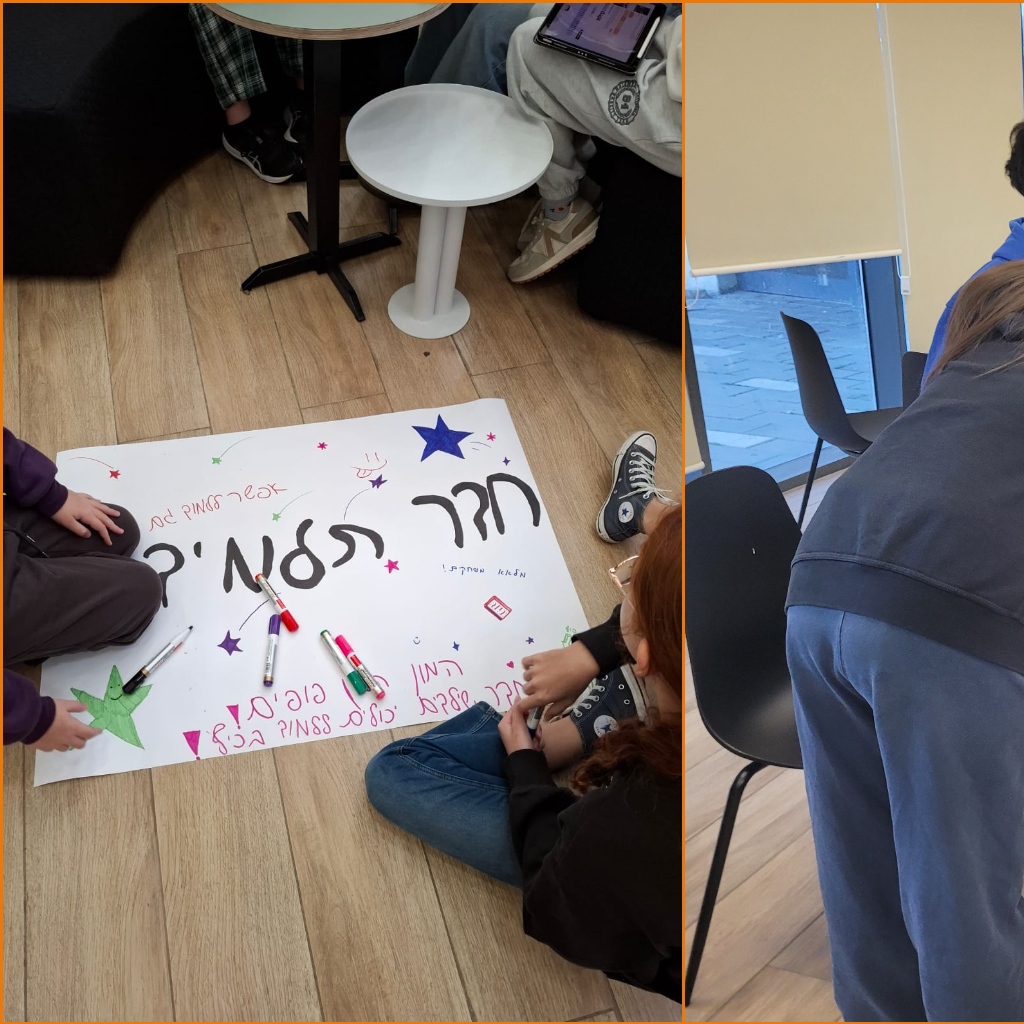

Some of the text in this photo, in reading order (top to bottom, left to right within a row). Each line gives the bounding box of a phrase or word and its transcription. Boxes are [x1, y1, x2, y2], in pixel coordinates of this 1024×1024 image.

[149, 482, 288, 532] אפשר ללמוד גם
[143, 472, 541, 608] חבר תלמיד
[411, 660, 463, 697] המון
[277, 713, 332, 738] ללמוד
[339, 702, 398, 728] יכולים
